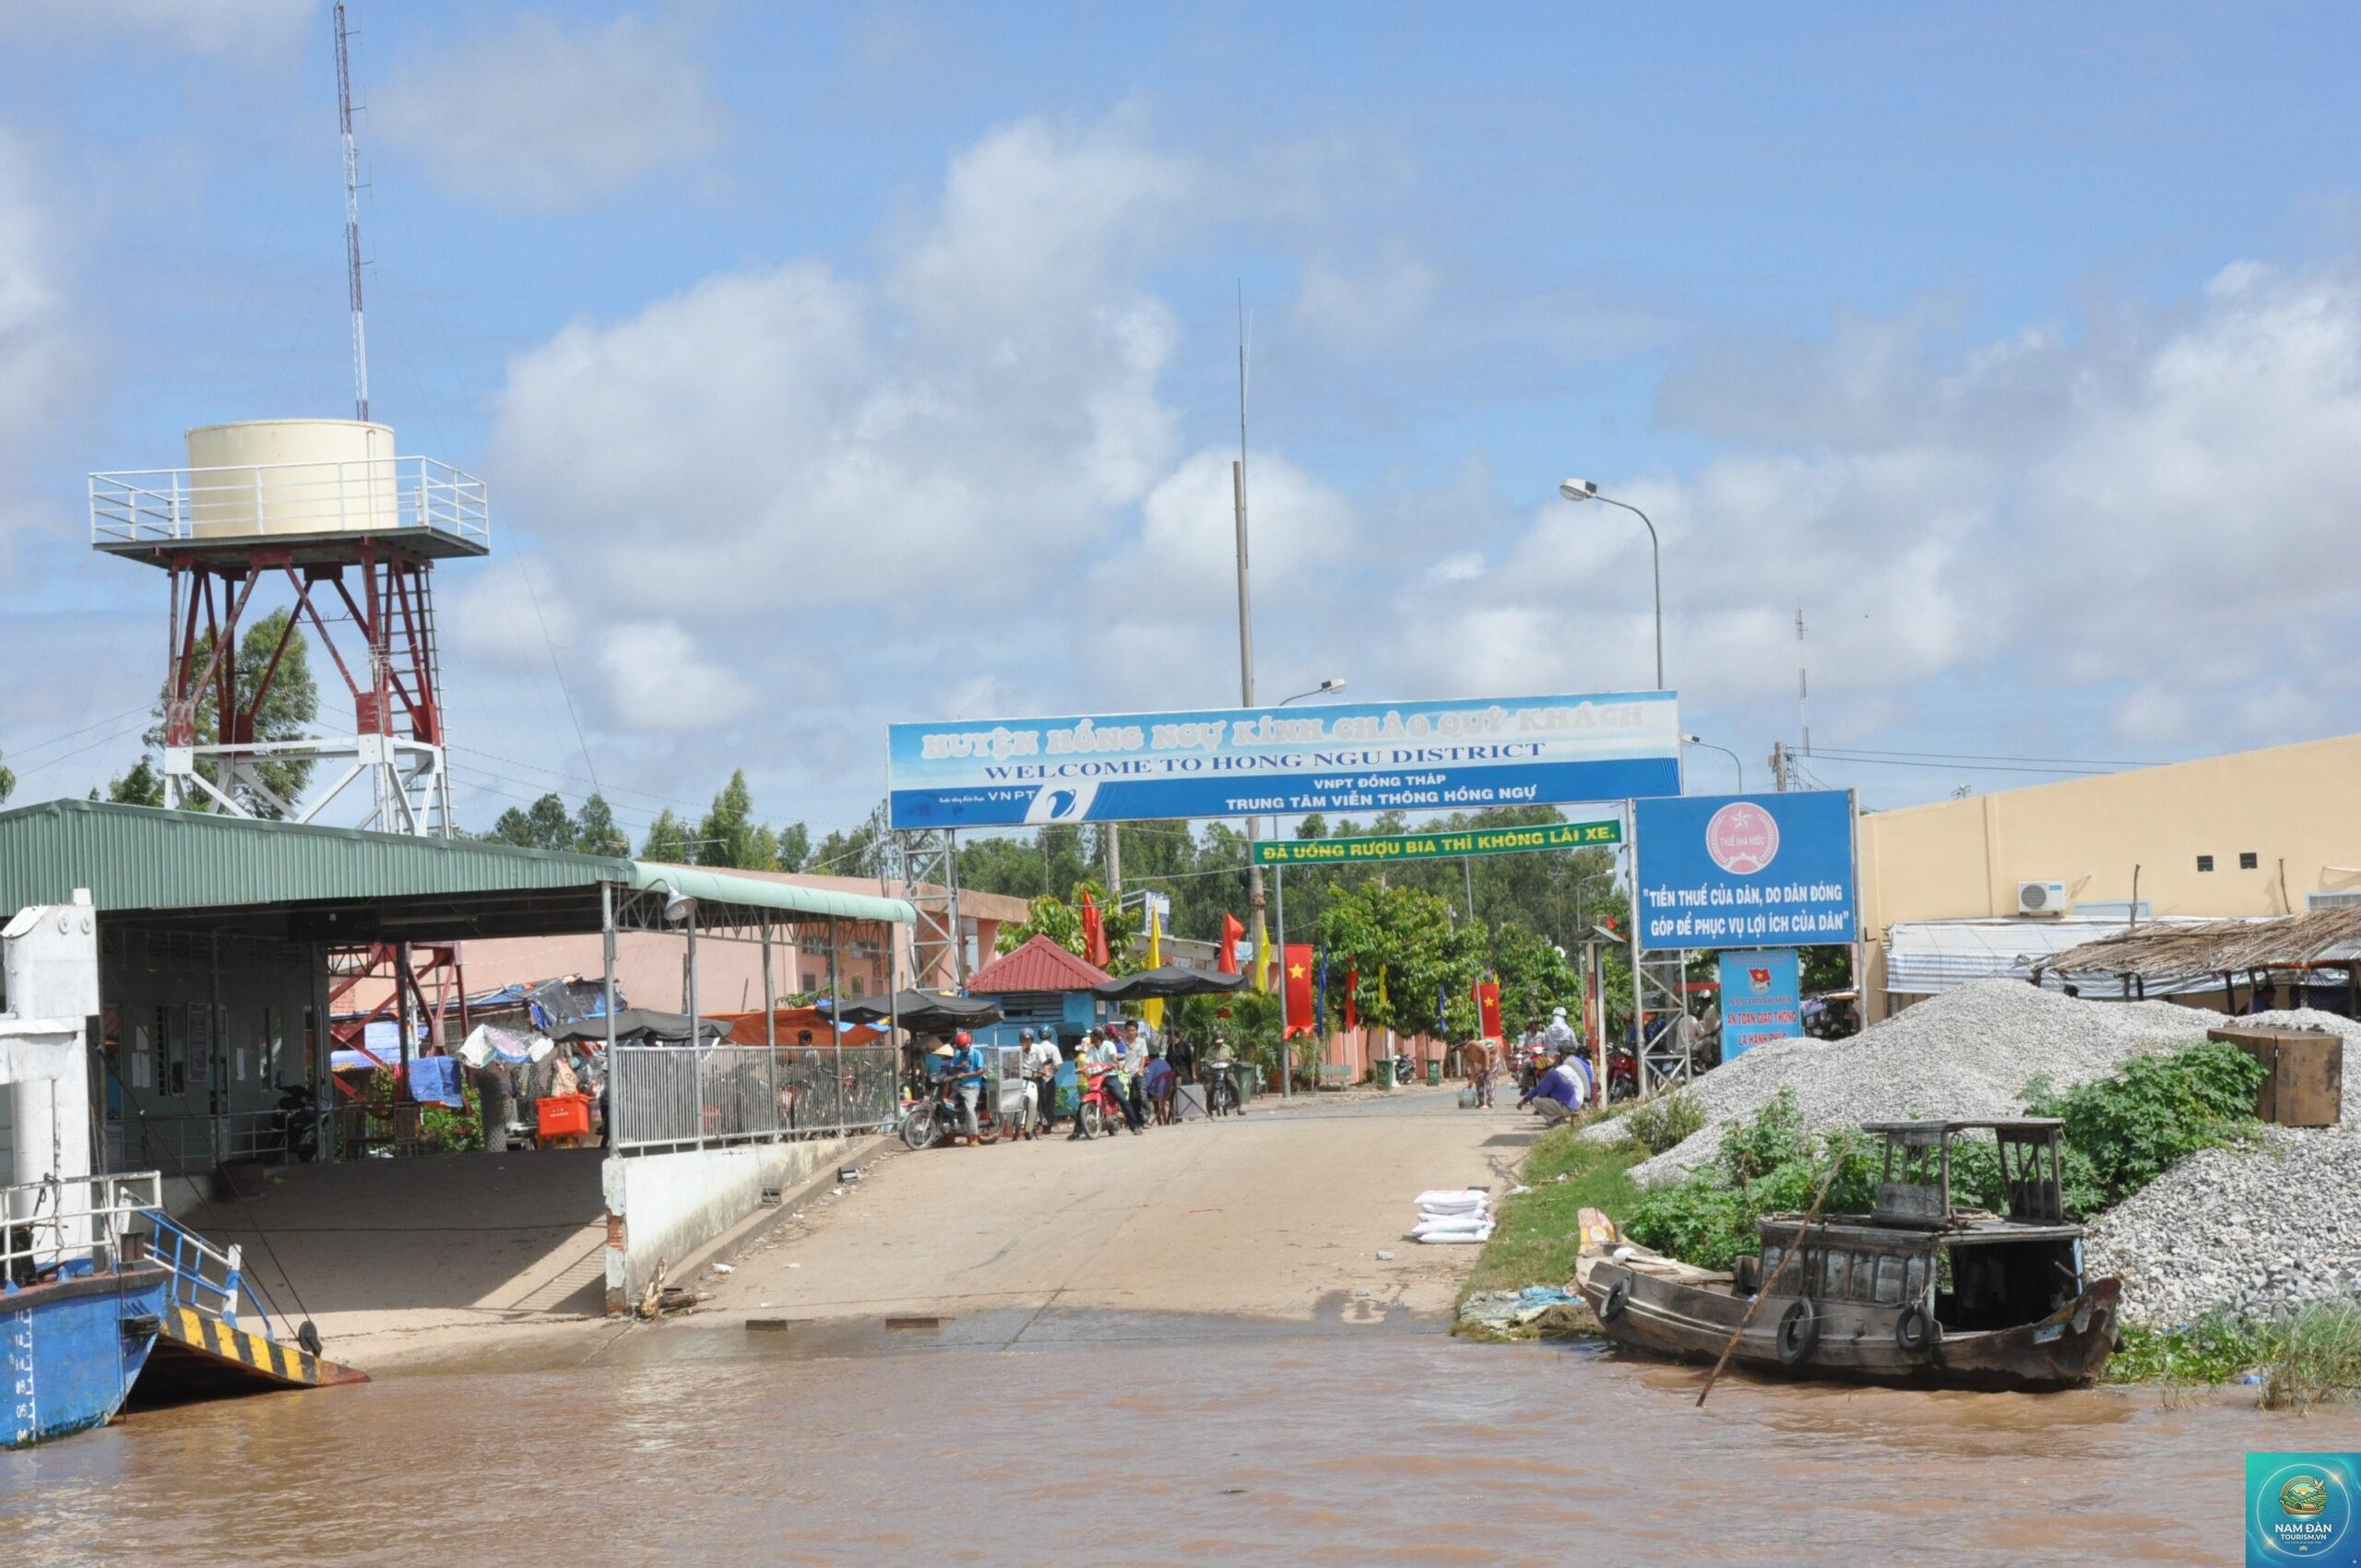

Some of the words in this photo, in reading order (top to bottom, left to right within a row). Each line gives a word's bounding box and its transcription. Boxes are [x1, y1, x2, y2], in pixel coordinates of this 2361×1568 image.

[921, 726, 1038, 761] HUYỆN
[984, 760, 1152, 780] WELCOME
[1160, 757, 1202, 773] TO
[1213, 753, 1301, 771] HONG
[1313, 751, 1382, 767] NGU
[1393, 742, 1546, 764] DISTRICT
[1313, 778, 1354, 790] VNPT
[1405, 771, 1446, 787] THÁP
[988, 790, 1035, 802] VNPT
[1226, 797, 1285, 811] TRUNG
[1289, 791, 1326, 809] TÂM
[1331, 789, 1372, 807] VIỄN
[1378, 789, 1439, 805] THÔNG
[1499, 782, 1537, 801] NGỰ
[1263, 843, 1288, 860] ĐÃ
[1293, 841, 1345, 859] UỐNG
[1350, 840, 1400, 859] RƯỢU
[1406, 839, 1436, 854] BIA
[1442, 834, 1472, 851] THÌ
[1478, 831, 1544, 849] KHÔNG
[1550, 826, 1580, 843] LÁI
[1585, 826, 1616, 840] XE.
[1679, 882, 1708, 907] THUẾ
[1710, 882, 1733, 906] CỦA
[1737, 883, 1763, 907] DÂN,
[1766, 886, 1782, 904] DO
[1785, 882, 1808, 903] DÂN
[1810, 880, 1843, 902] ĐÓNG
[1651, 915, 1674, 937] GÓP
[1677, 910, 1692, 936] ĐỂ
[1695, 917, 1726, 939] PHỤC
[1728, 916, 1744, 939] VỤ
[1747, 913, 1766, 939] LỢI
[1769, 911, 1789, 932] ÍCH
[1792, 909, 1817, 932] CỦA
